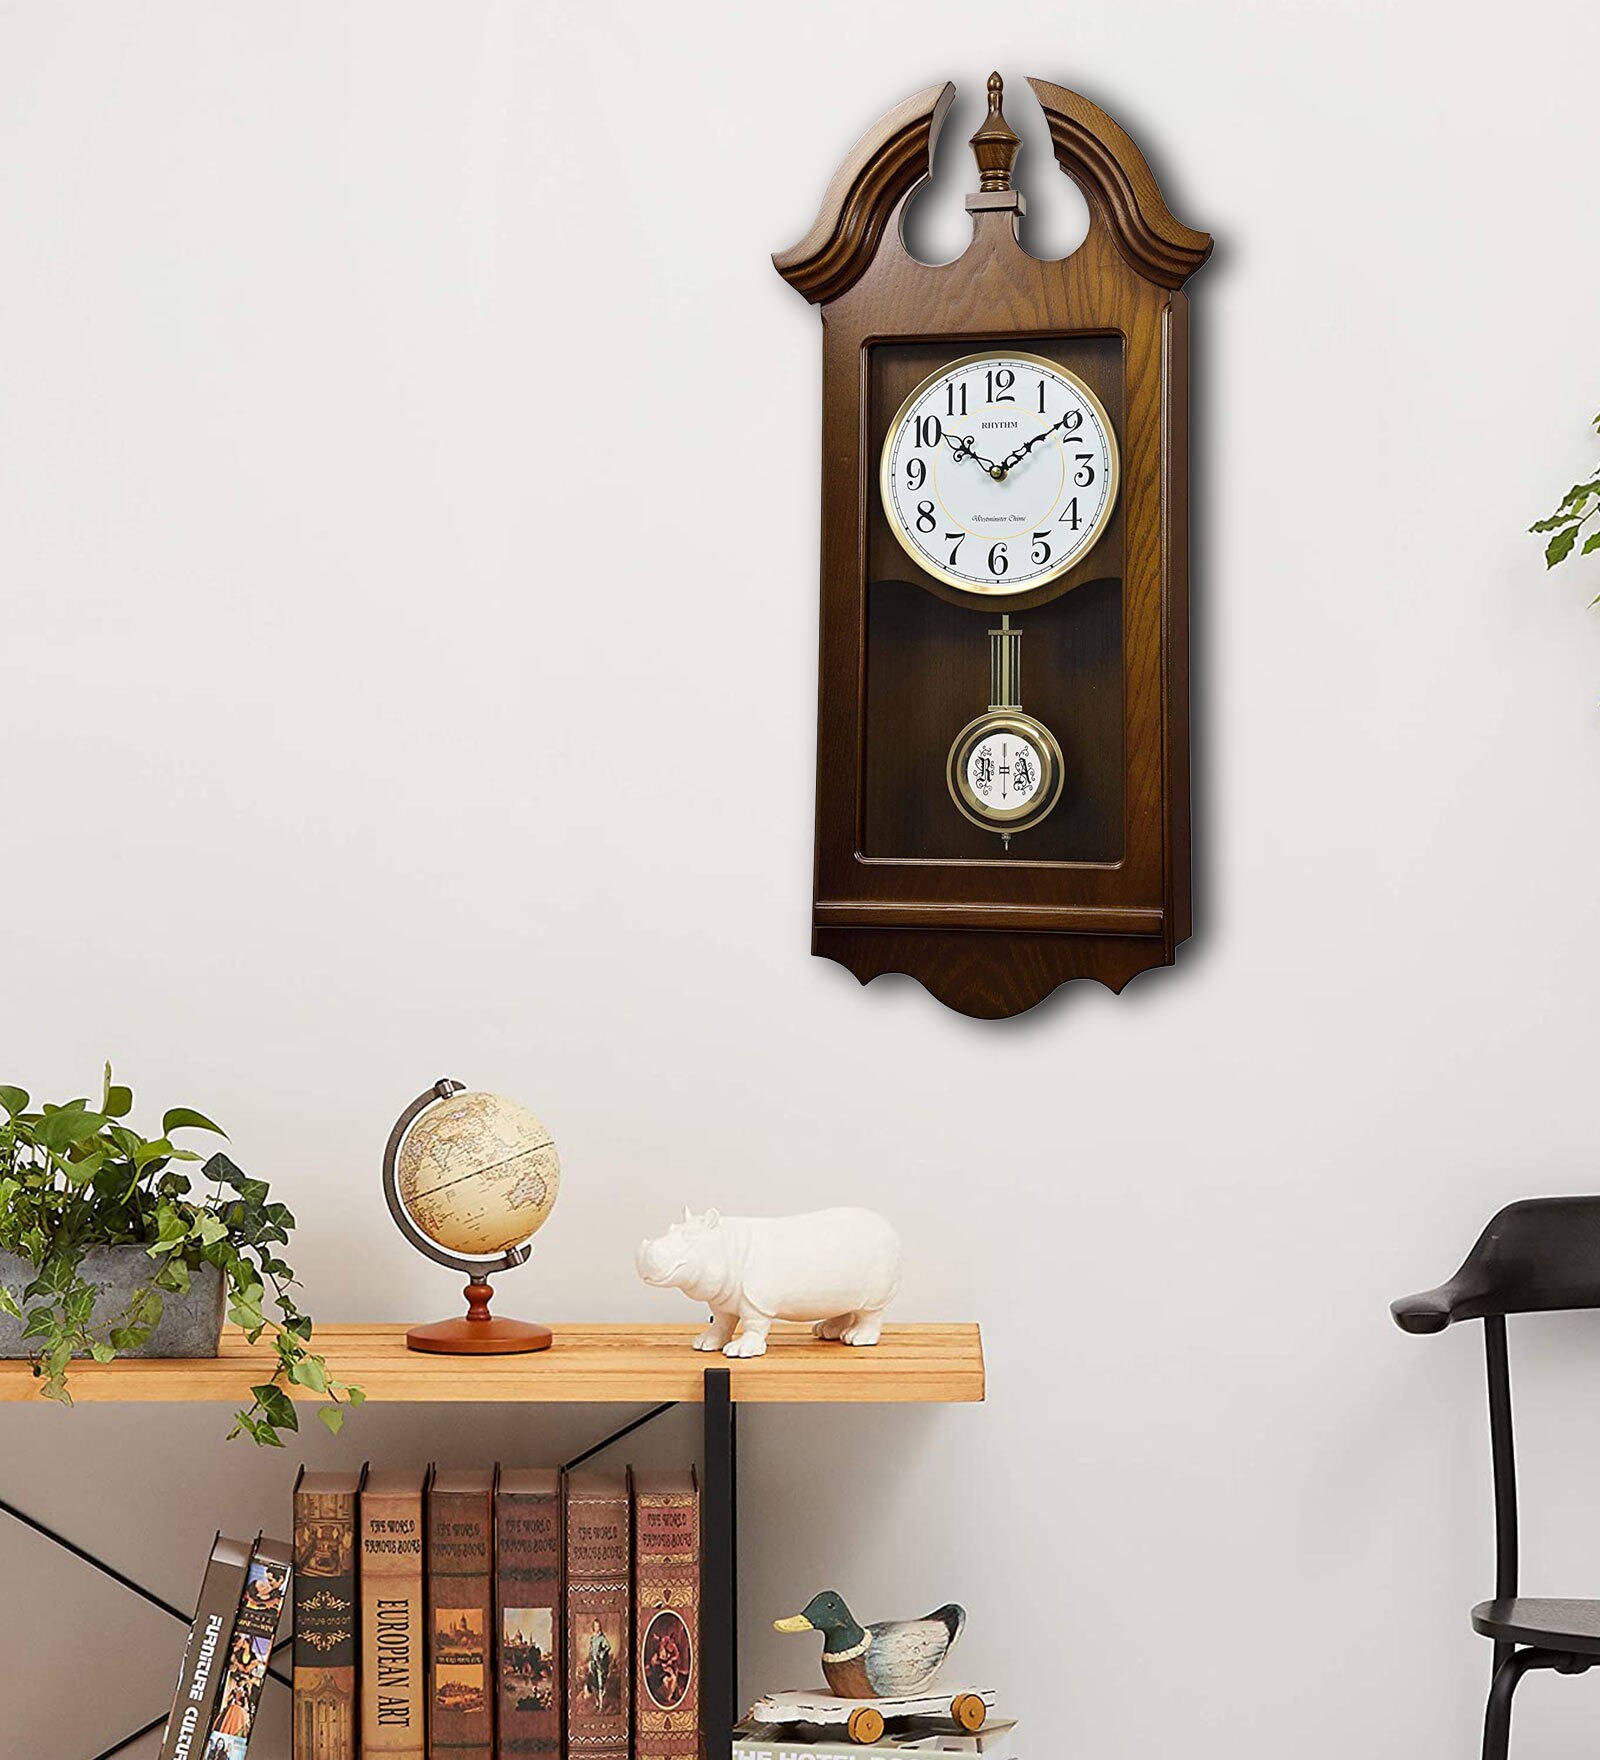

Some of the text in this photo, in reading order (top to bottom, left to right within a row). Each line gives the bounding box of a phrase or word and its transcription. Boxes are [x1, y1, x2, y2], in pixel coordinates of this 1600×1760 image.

[946, 383, 967, 416] 11
[985, 369, 1015, 403] 12
[1038, 381, 1045, 414] 1
[914, 415, 942, 448] 10
[1063, 410, 1083, 443] 2
[907, 458, 926, 490] 9
[1074, 454, 1095, 487] 3
[916, 501, 936, 533] 8
[1059, 497, 1082, 531] 4
[945, 533, 965, 565] 7
[988, 543, 1008, 575] 6
[1031, 530, 1052, 565] 5
[189, 1614, 223, 1702] FURNITURE
[377, 1599, 409, 1727] EUROPEAN ART
